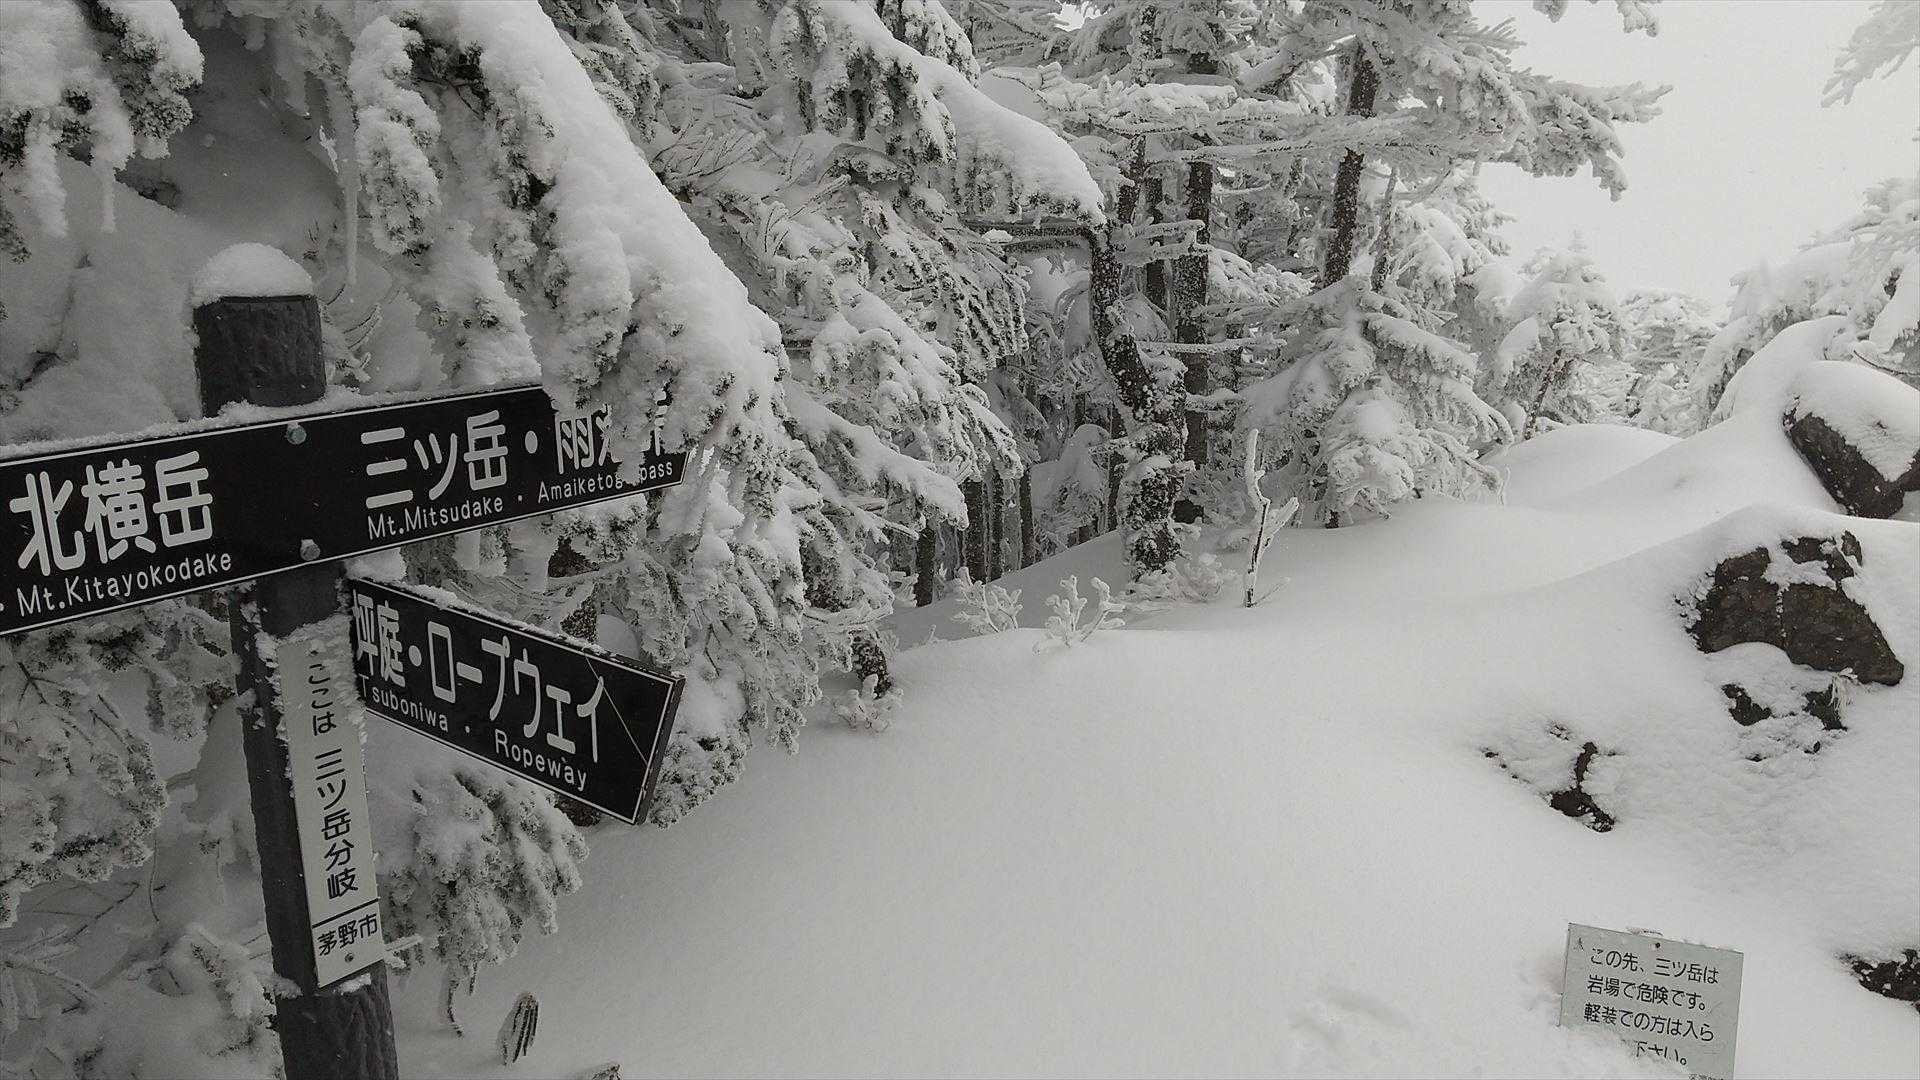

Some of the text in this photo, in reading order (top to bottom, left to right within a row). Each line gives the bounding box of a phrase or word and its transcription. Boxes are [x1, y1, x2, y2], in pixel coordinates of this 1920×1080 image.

[361, 401, 668, 509] 三ツ岳・雨
[9, 450, 214, 577] 北横岳
[367, 496, 504, 540] Mt.Mitsudake
[537, 470, 625, 504] Amaiketog
[16, 552, 232, 617] Mt.Kitayokodake
[307, 663, 360, 900] ここは 三ツ岳分岐
[494, 728, 587, 792] Ropeway
[317, 912, 378, 957] 茅野市
[1583, 1001, 1715, 1042] 軽装での方は入ら
[1586, 973, 1706, 1011] 岩場で危険です。
